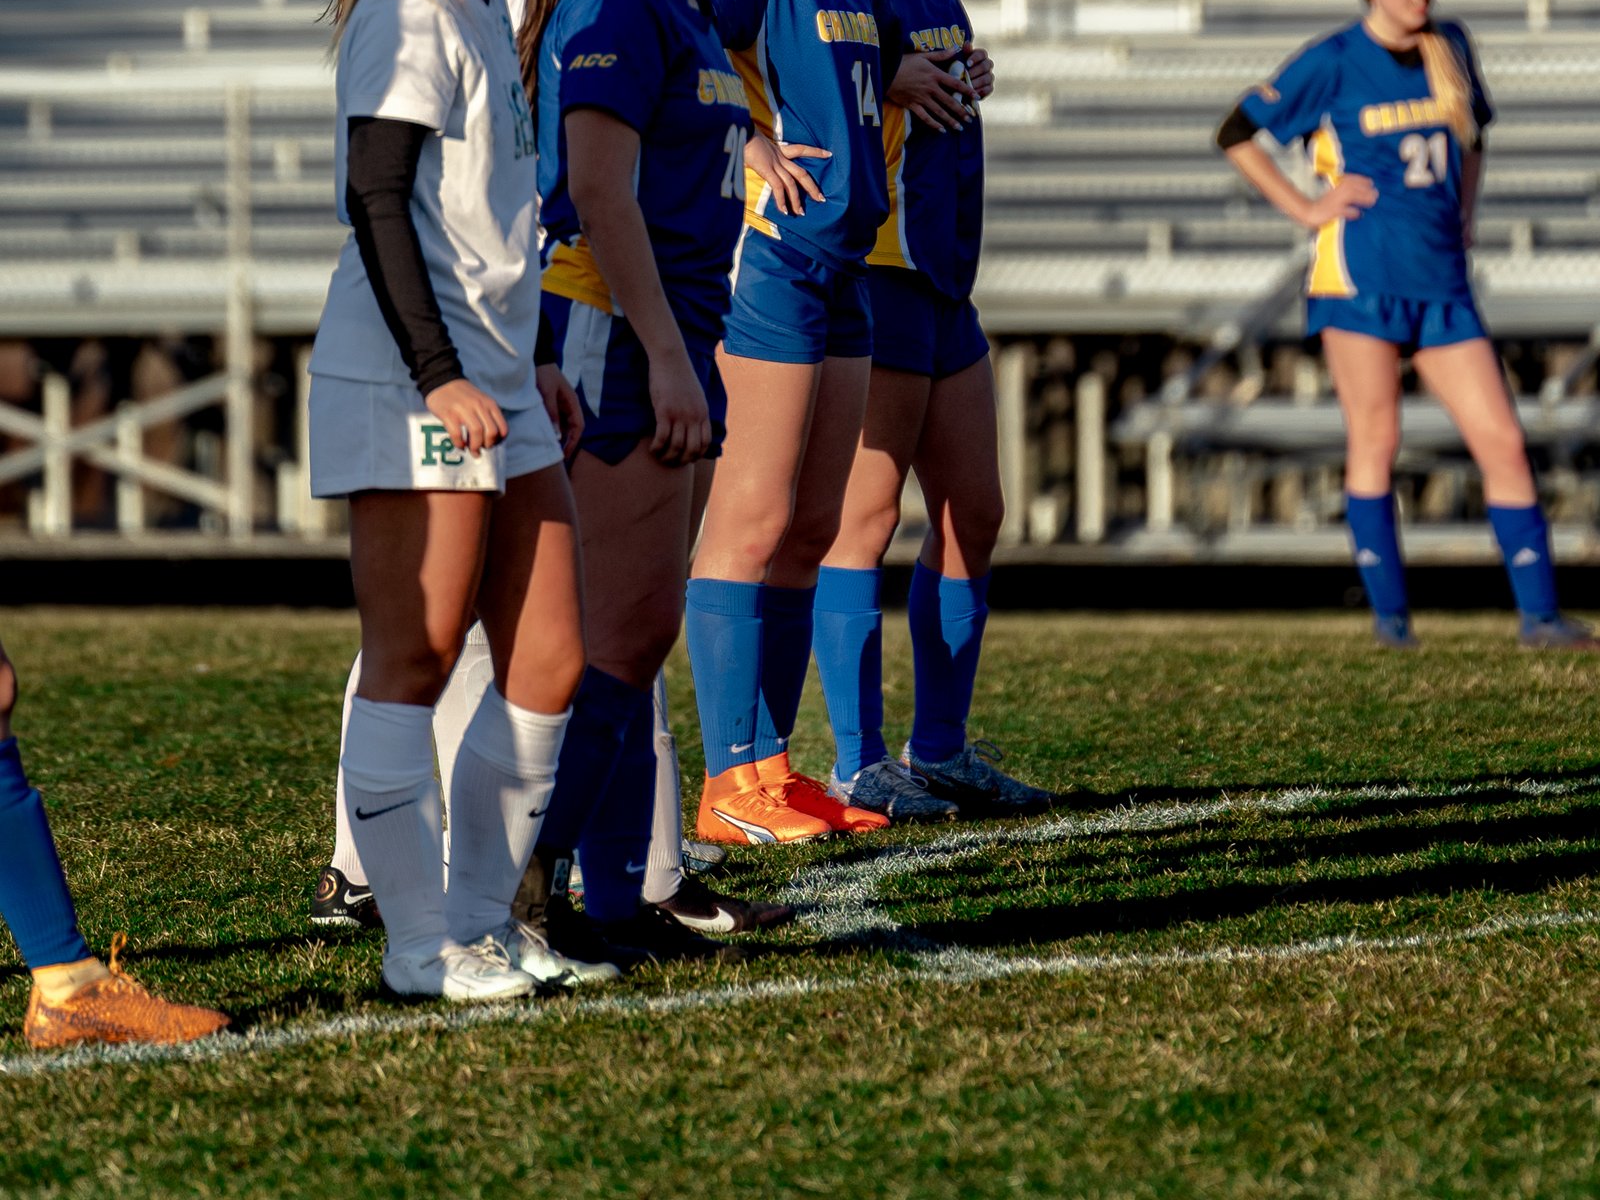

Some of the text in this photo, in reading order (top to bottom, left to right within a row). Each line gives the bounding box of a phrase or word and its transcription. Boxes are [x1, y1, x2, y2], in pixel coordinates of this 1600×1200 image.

[569, 53, 617, 71] ACC
[851, 60, 881, 127] 14
[1400, 132, 1447, 188] 21
